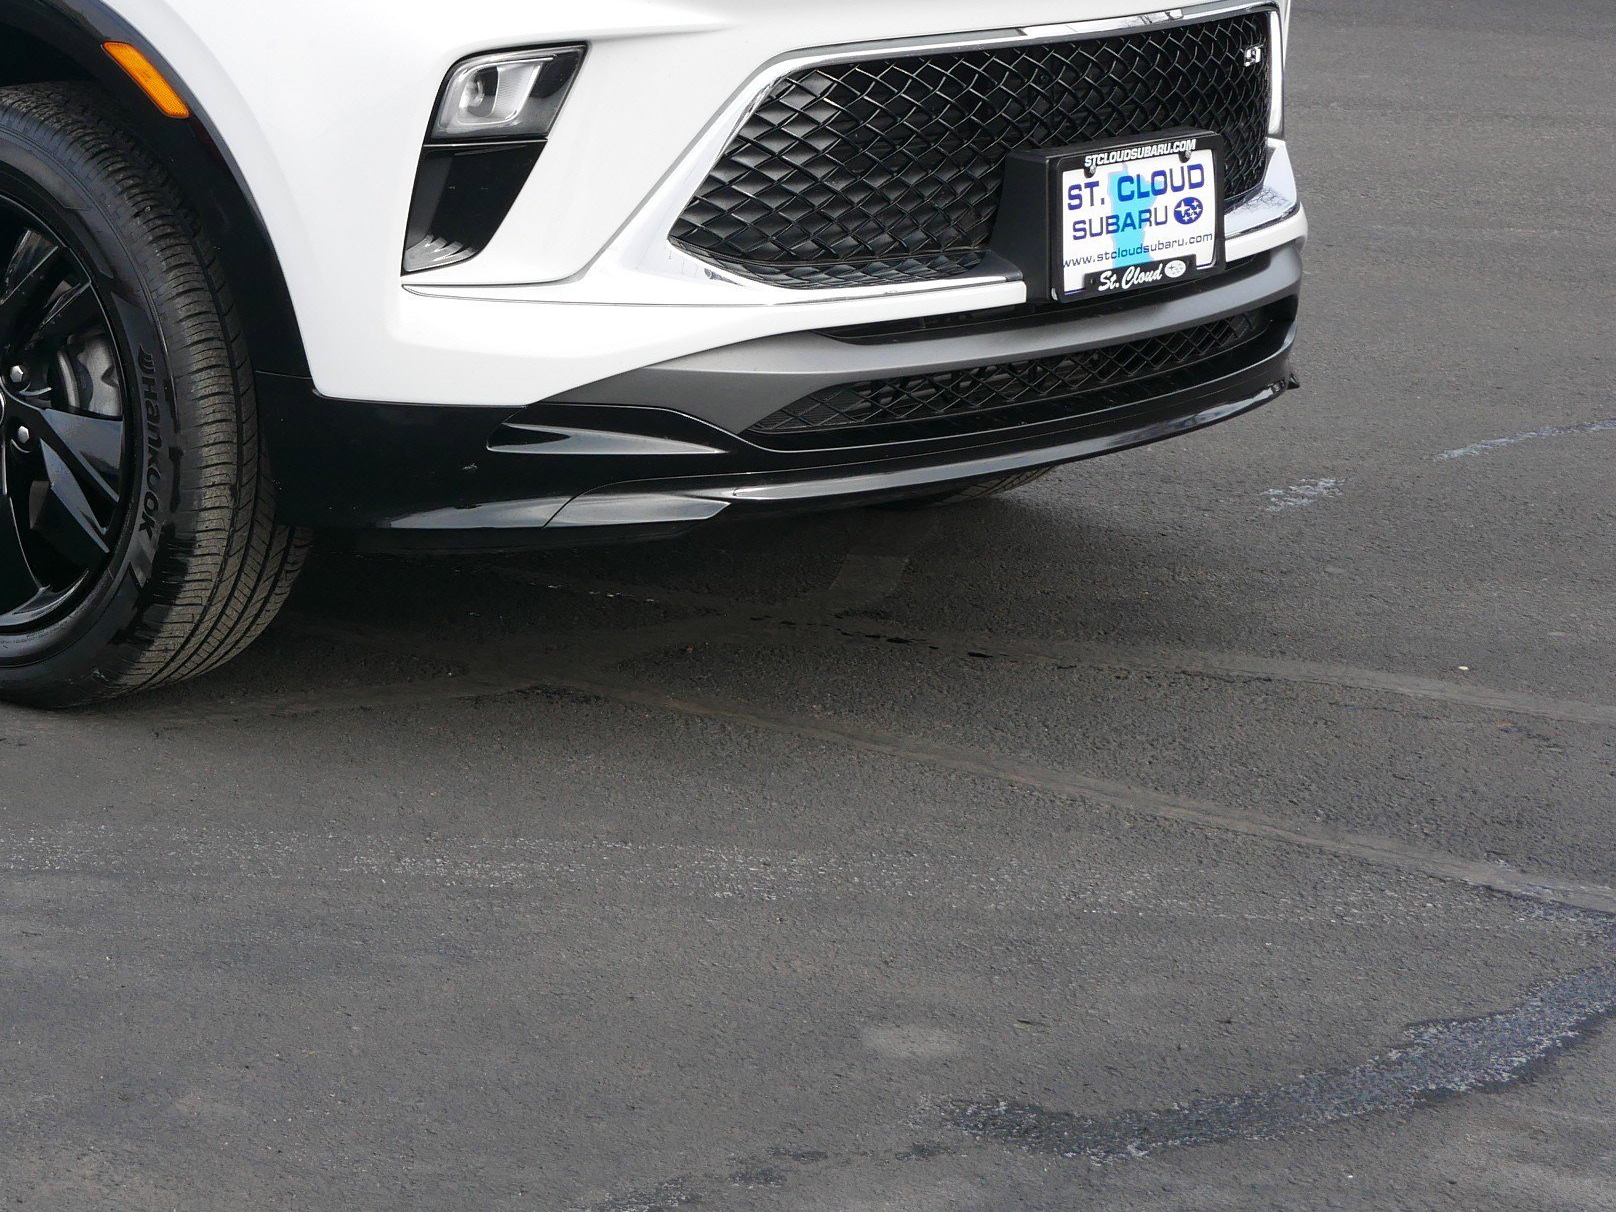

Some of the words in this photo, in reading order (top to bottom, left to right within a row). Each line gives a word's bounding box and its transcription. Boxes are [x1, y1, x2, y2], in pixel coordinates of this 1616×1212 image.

[1084, 138, 1197, 168] STCLOUDSUBARU.COM
[1067, 180, 1106, 211] ST.
[1117, 163, 1206, 203] CLOUD
[1072, 205, 1169, 241] SUBARU
[1063, 232, 1213, 269] www.stcloudsubaru.com
[1098, 270, 1121, 292] St.
[1121, 263, 1163, 290] Cloud
